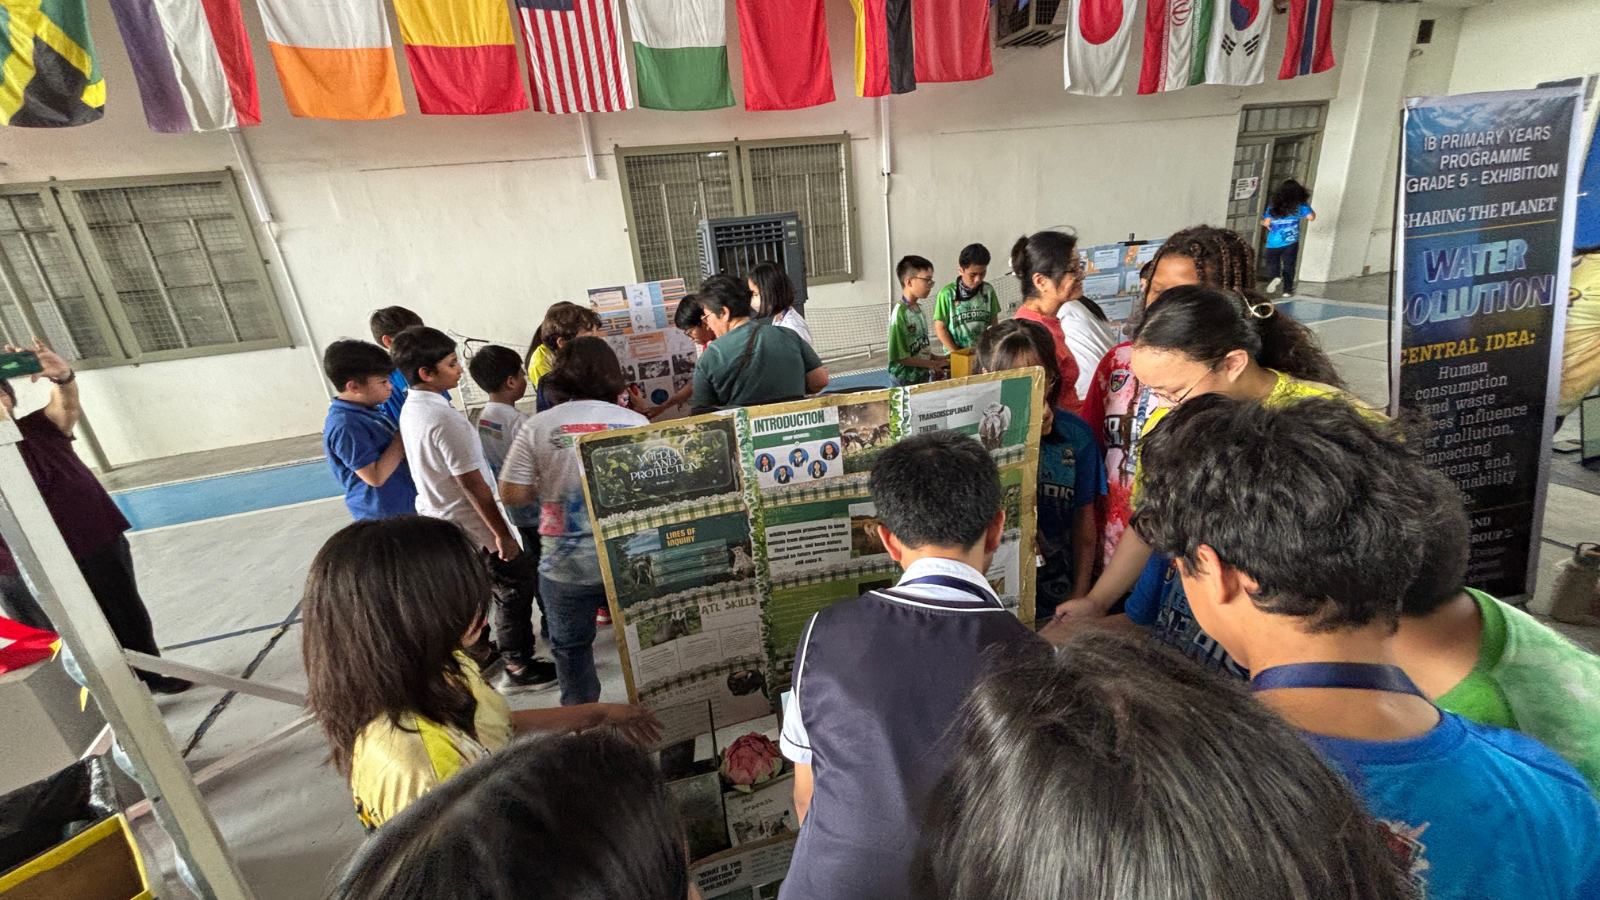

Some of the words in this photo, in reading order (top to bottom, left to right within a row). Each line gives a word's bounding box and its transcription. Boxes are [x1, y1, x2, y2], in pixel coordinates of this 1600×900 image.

[1424, 135, 1437, 151] IB
[1440, 130, 1504, 149] PRIMARY
[1508, 126, 1551, 143] YEARS
[1440, 147, 1532, 170] PROGRAMME
[1406, 175, 1455, 193] GRADE
[1459, 173, 1468, 188] 5
[1481, 164, 1559, 186] EXHIBITION
[1404, 208, 1466, 229] SHARING
[1468, 204, 1499, 221] THE
[1501, 196, 1557, 217] PLANET
[1424, 238, 1528, 283] WATER
[1400, 338, 1479, 366] CENTRAL
[1484, 330, 1536, 352] IDEA:
[1437, 361, 1488, 380] Human
[1415, 374, 1508, 400] consumption
[918, 404, 974, 422] TRANSDISCIPLINARY
[1424, 398, 1450, 416] and
[1456, 393, 1496, 411] waste
[1460, 404, 1528, 426] influence
[754, 410, 826, 433] INTRODUCTION
[653, 456, 678, 468] AND
[1422, 442, 1492, 465] impacting
[1484, 453, 1511, 470] and
[630, 460, 700, 482] PROTECTION
[666, 530, 686, 540] LINES
[686, 528, 696, 536] OF
[667, 536, 696, 546] INQUIRY
[702, 604, 721, 614] ATL
[726, 597, 758, 610] SKILLS
